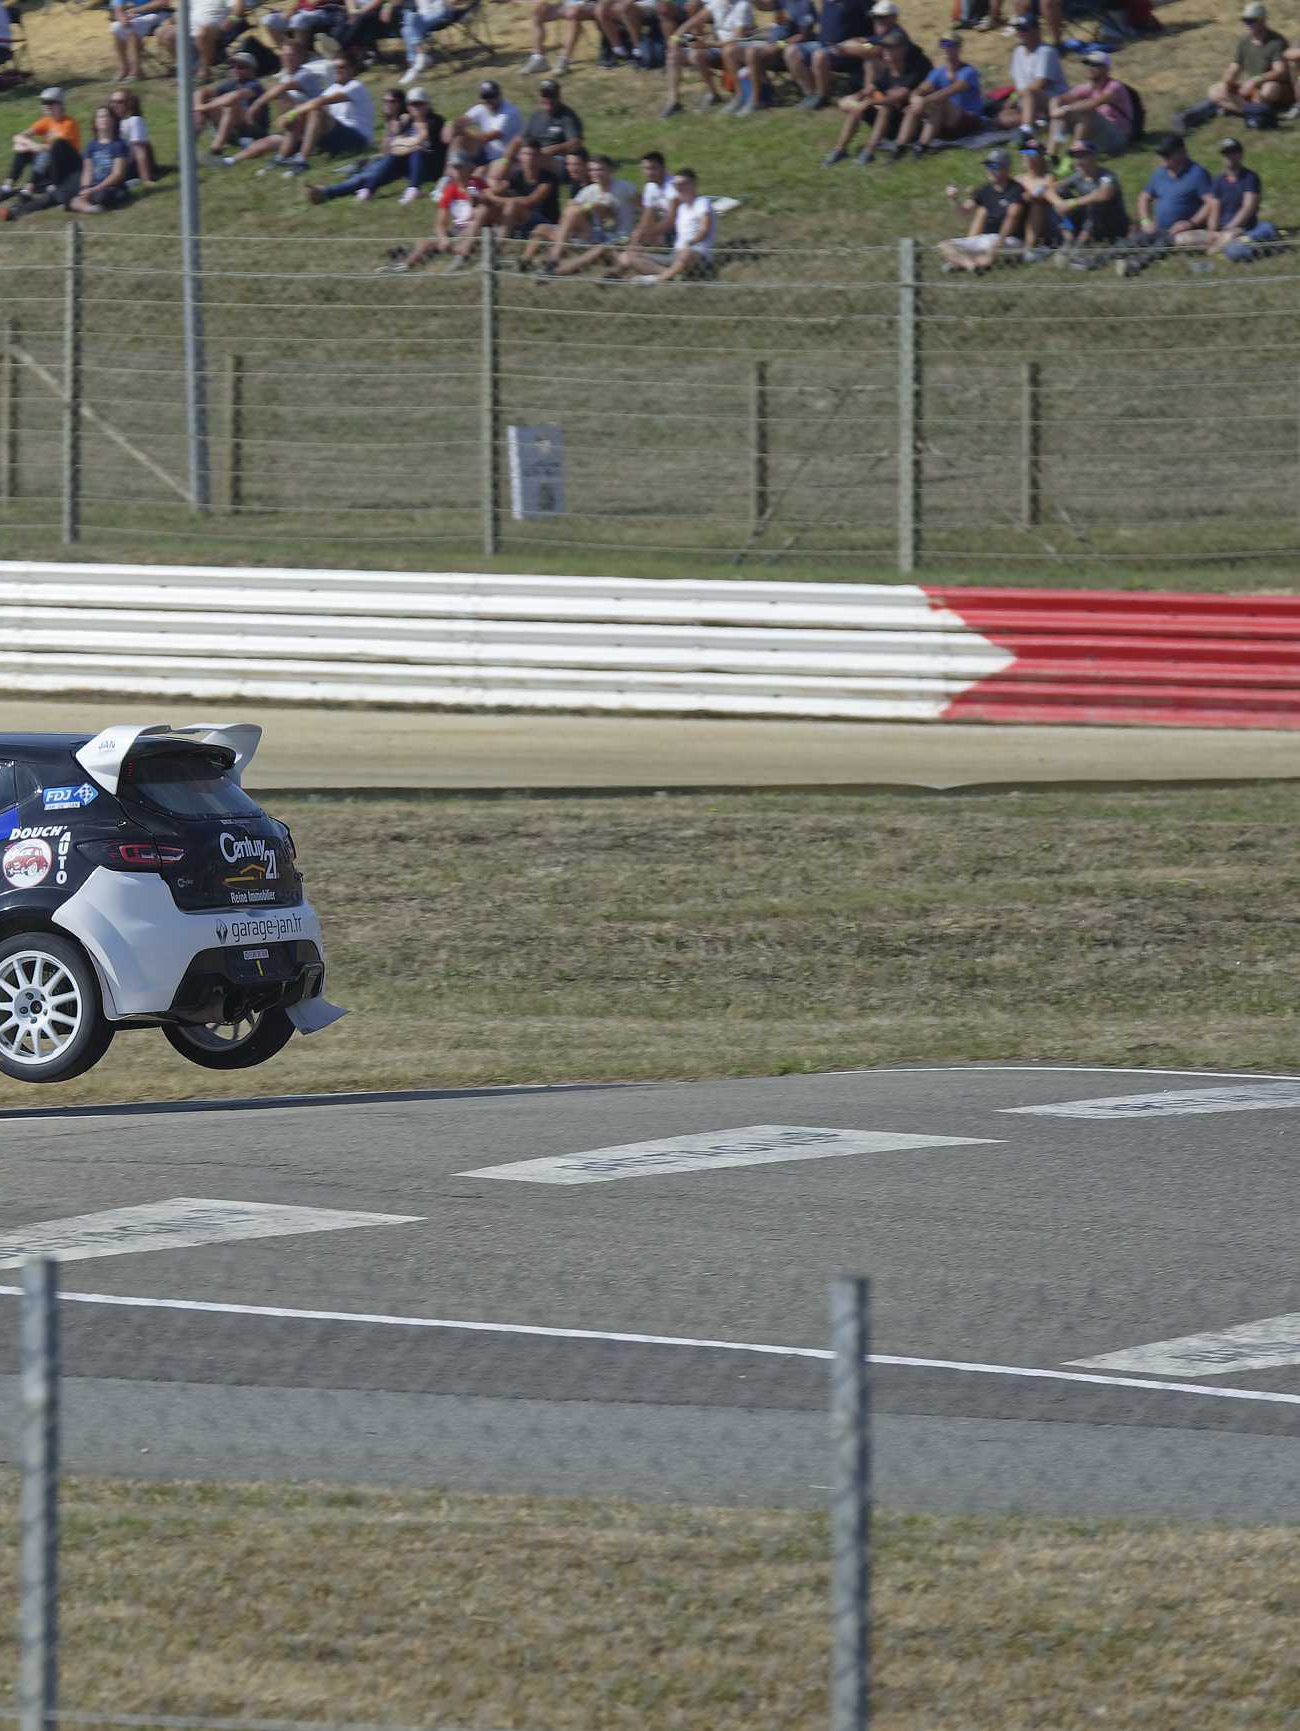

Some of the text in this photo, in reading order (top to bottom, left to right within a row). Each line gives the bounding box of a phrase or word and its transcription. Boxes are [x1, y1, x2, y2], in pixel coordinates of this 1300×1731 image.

[46, 789, 73, 802] FDJ
[9, 826, 68, 840] DOUCH'
[220, 832, 266, 863] Century
[56, 832, 71, 885] AUTO
[231, 912, 302, 942] garage-jan.fr
